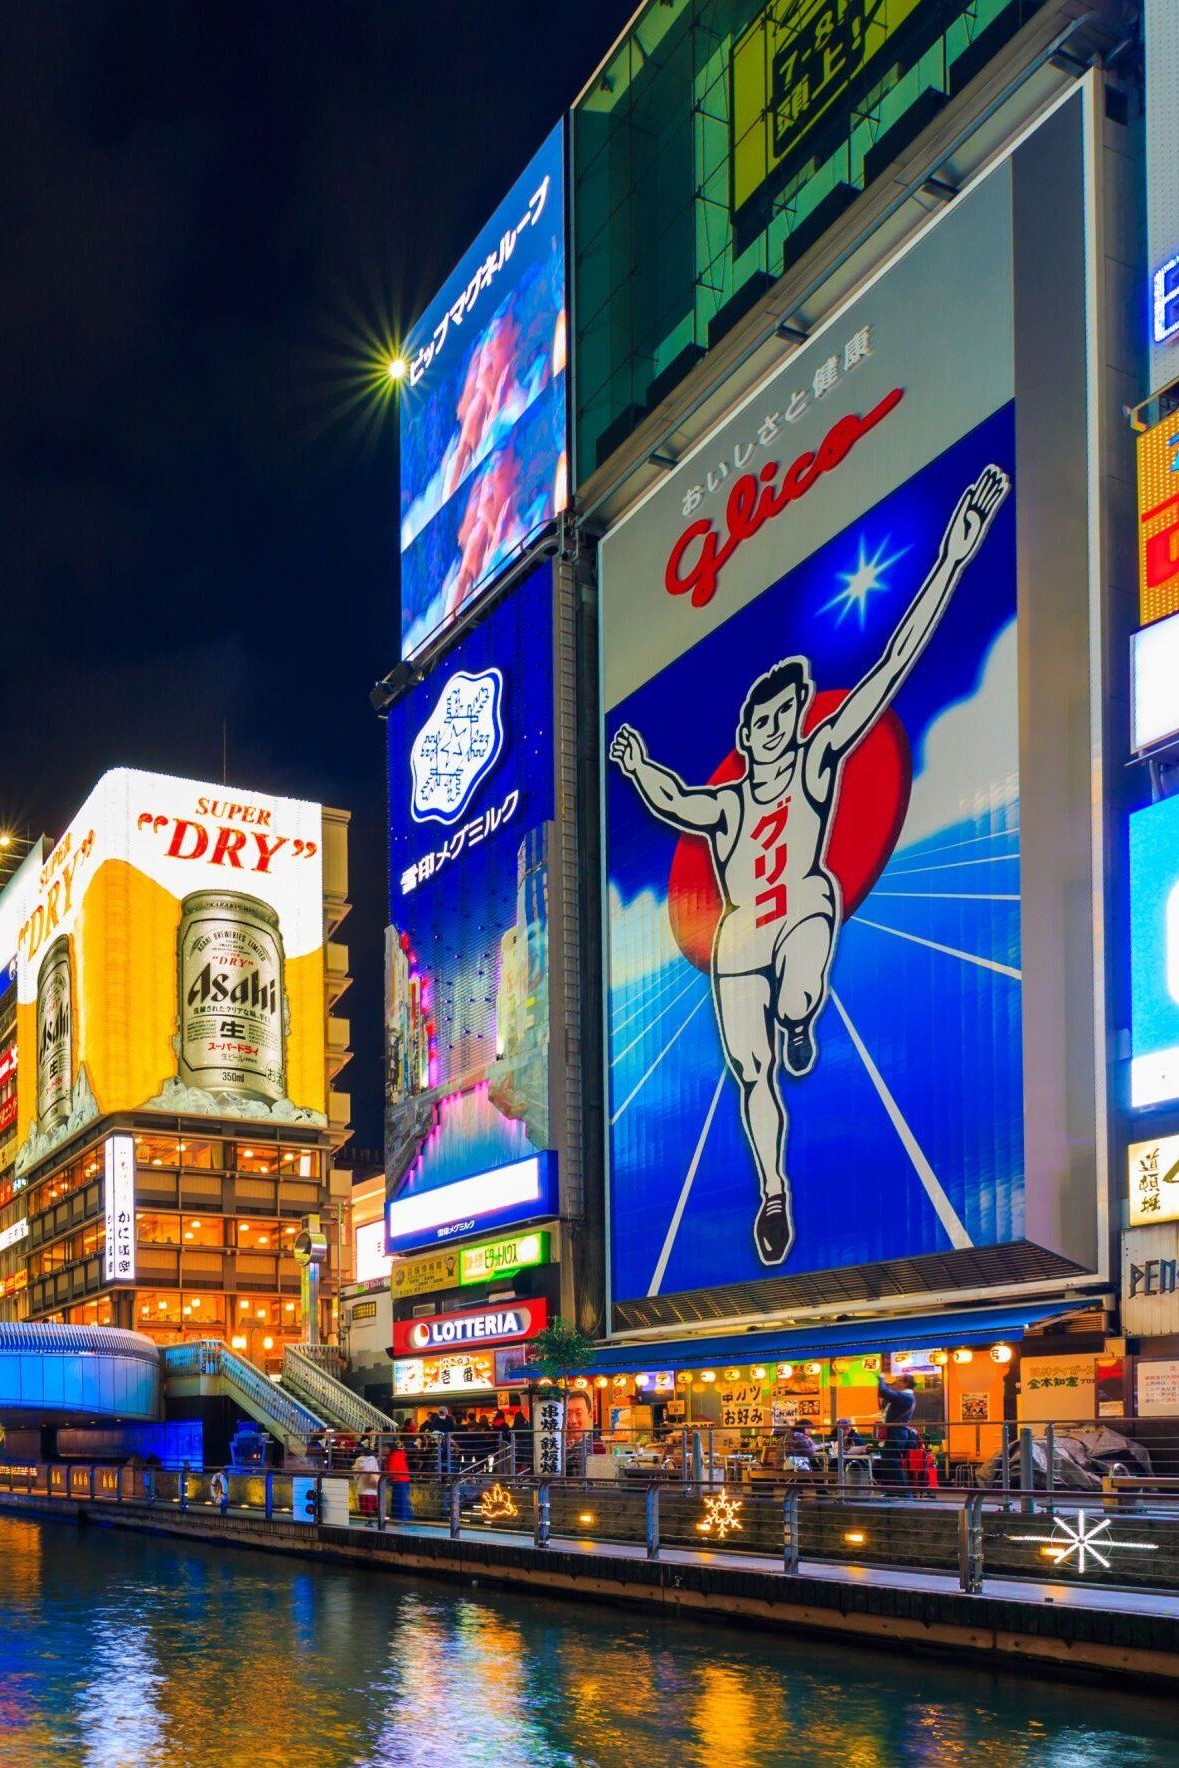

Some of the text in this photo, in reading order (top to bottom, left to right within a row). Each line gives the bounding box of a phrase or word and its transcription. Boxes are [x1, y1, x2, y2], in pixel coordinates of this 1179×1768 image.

[409, 174, 551, 387] ピップマグネループ
[681, 324, 873, 517] おいしさと健康
[664, 386, 905, 609] Glico
[195, 797, 272, 828] SUPER
[400, 788, 519, 896] 雪印メグミルク
[749, 795, 792, 929] グリコ
[186, 962, 277, 1015] Asahi
[207, 1042, 259, 1056] スーパードライ
[220, 1020, 246, 1040] 生
[222, 1071, 245, 1083] 350ml
[1138, 1147, 1161, 1213] 道頓堀
[1128, 1258, 1179, 1300] PEN
[431, 1311, 519, 1343] LOTTERIA
[724, 1408, 763, 1426] お好み
